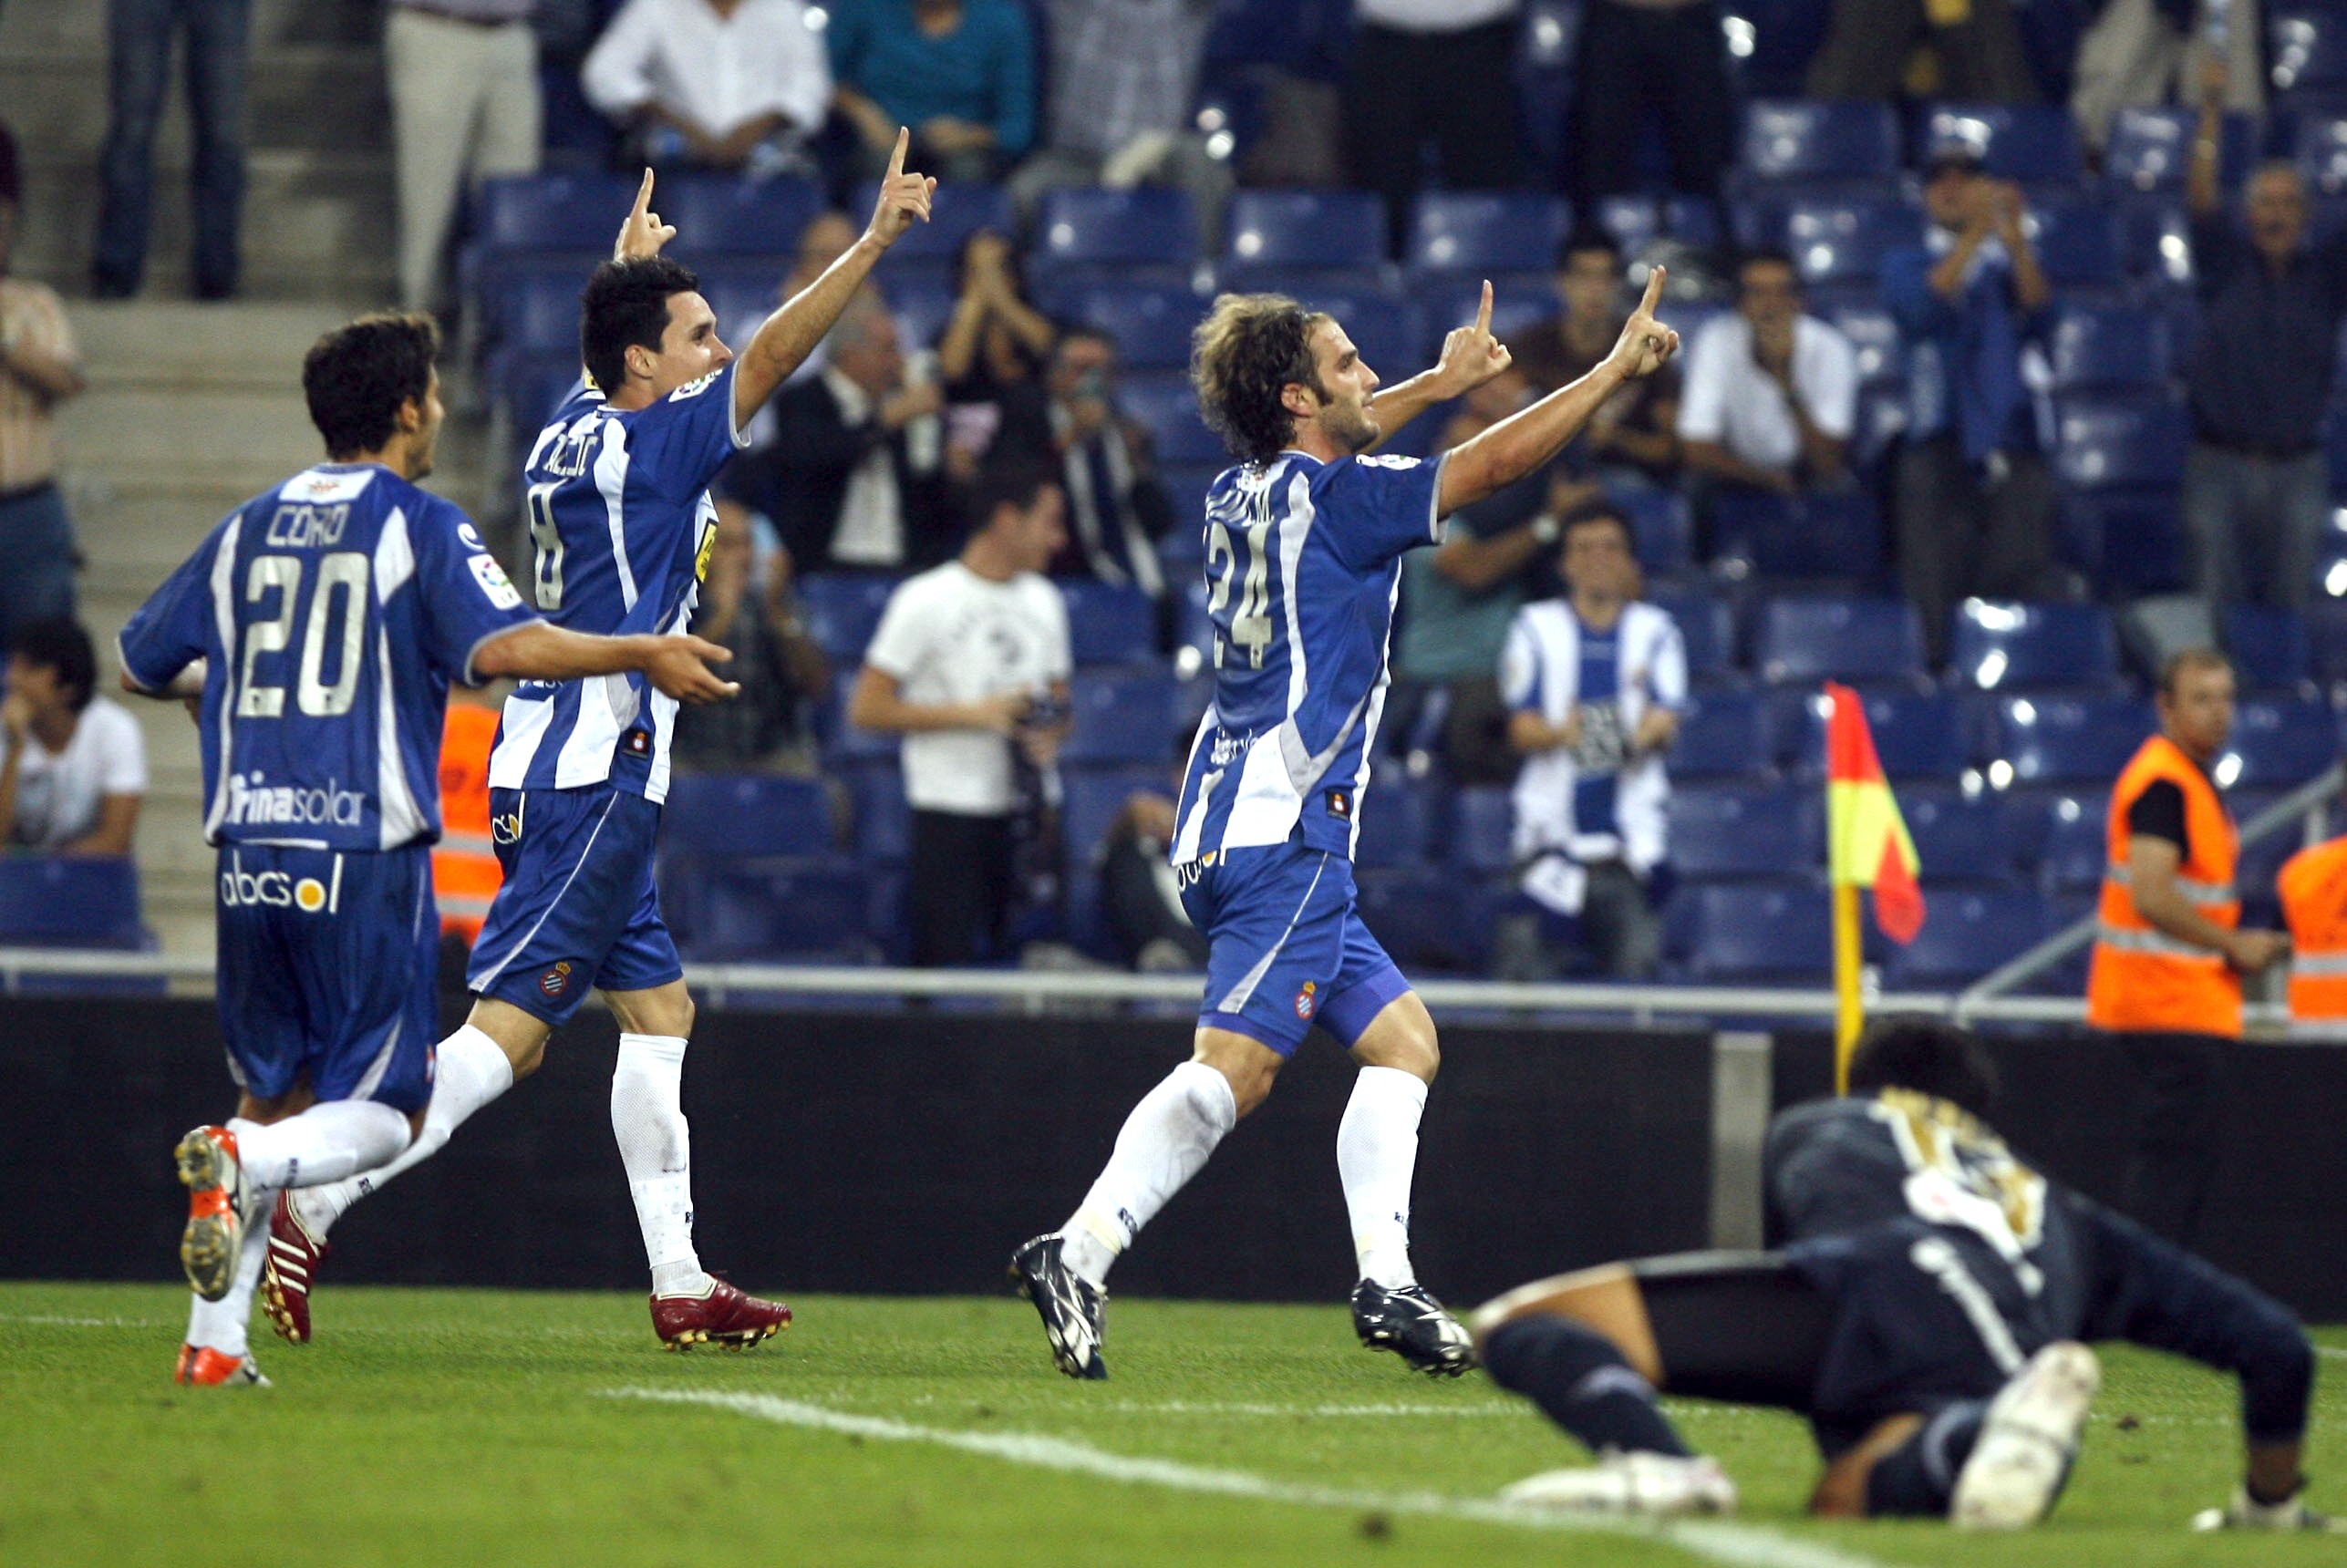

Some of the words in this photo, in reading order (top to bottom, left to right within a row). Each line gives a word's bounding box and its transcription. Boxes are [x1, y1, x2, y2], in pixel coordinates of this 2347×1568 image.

[265, 502, 349, 547] CORO
[237, 552, 368, 717] 20
[1208, 520, 1272, 669] 24
[221, 849, 344, 914] abcsol
